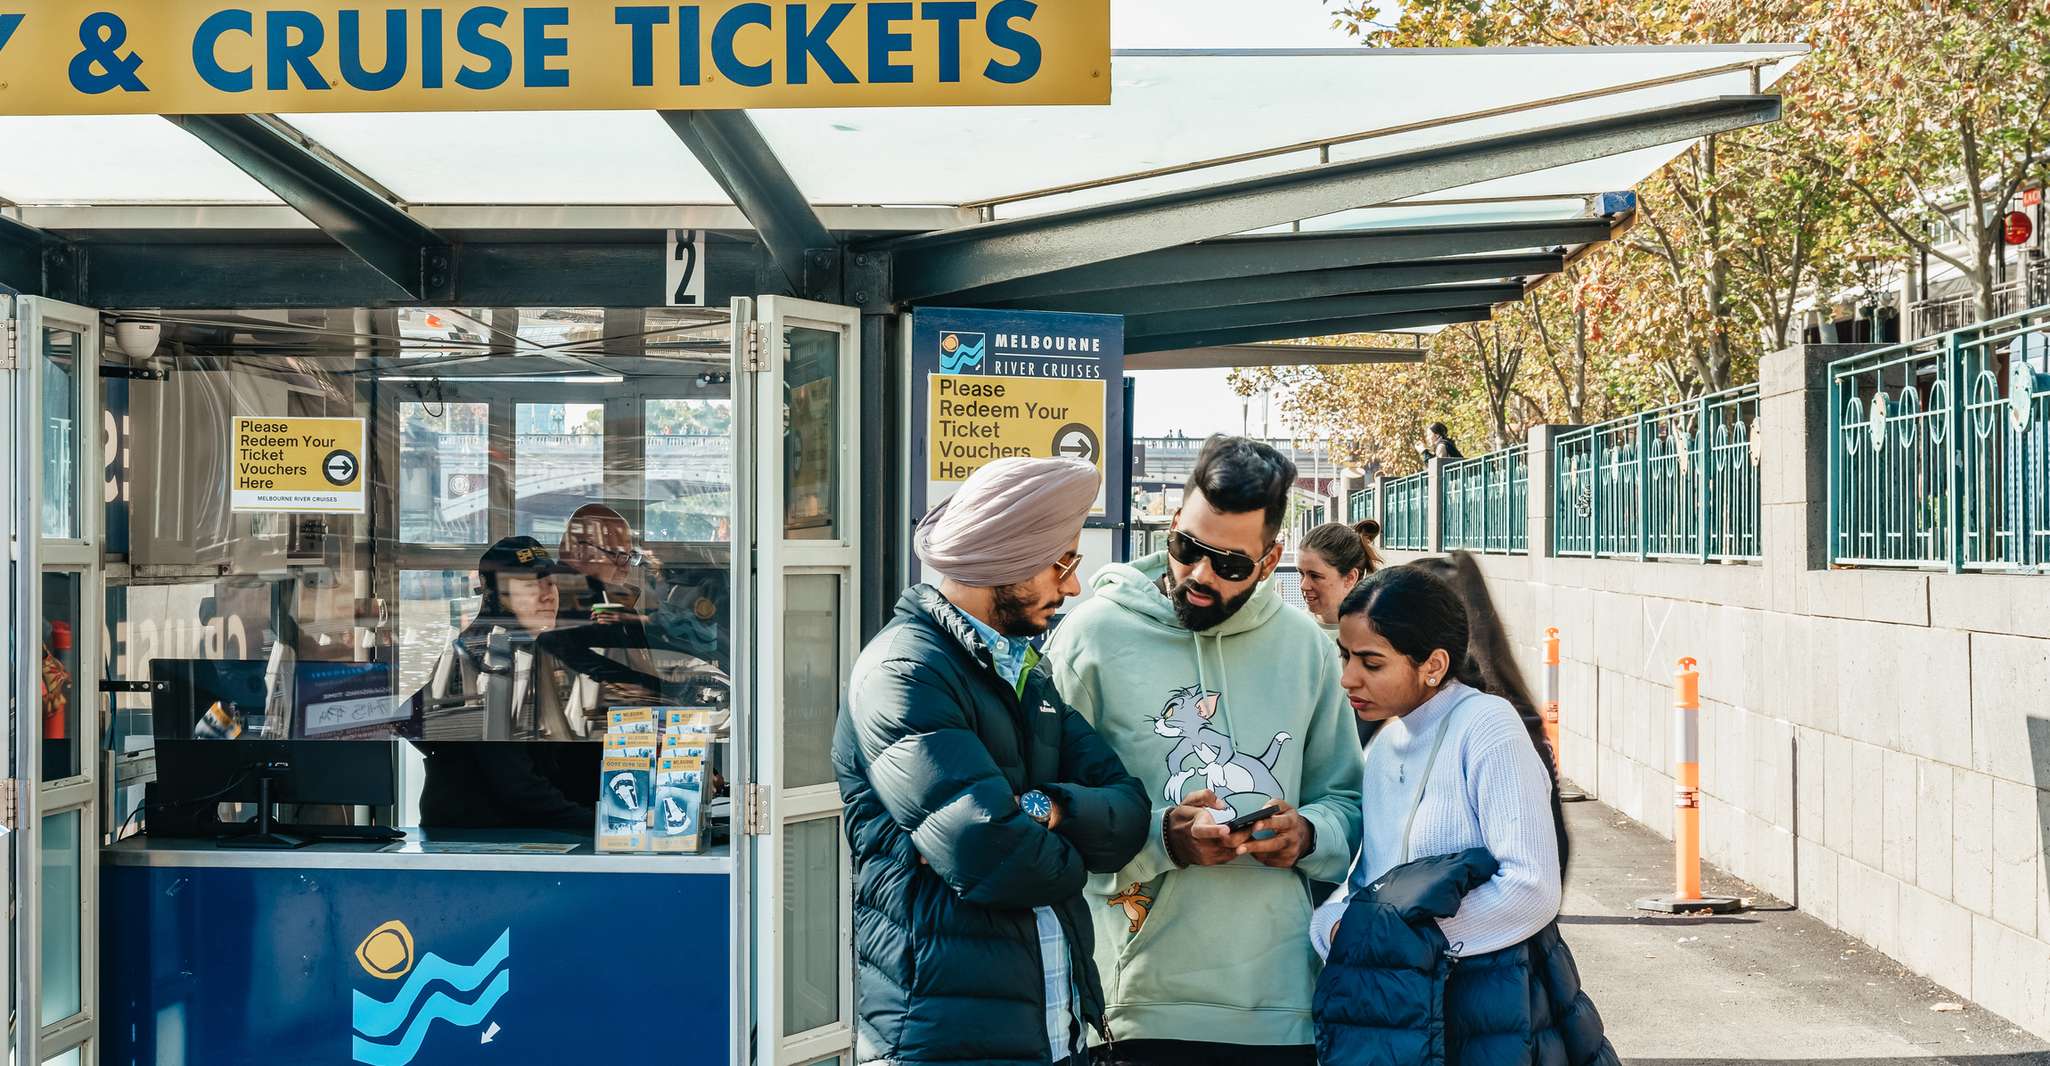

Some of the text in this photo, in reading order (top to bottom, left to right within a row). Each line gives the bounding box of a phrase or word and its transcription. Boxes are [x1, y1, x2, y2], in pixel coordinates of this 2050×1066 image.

[69, 12, 148, 94] &
[193, 7, 569, 92] CRUISE
[615, 0, 1042, 87] TICKETS
[675, 243, 697, 304] 2
[995, 334, 1100, 352] MELBOURNE
[995, 361, 1100, 378] RIVER CRUISES
[940, 379, 1005, 397] Please
[940, 399, 1069, 420] Redeem Your
[241, 421, 288, 433] Please
[939, 420, 1000, 438] Ticket
[240, 435, 336, 448] Redeem Your
[939, 441, 1031, 459] Vouchers
[240, 449, 284, 461] Ticket
[240, 463, 307, 476] Vouchers
[240, 477, 274, 489] Here
